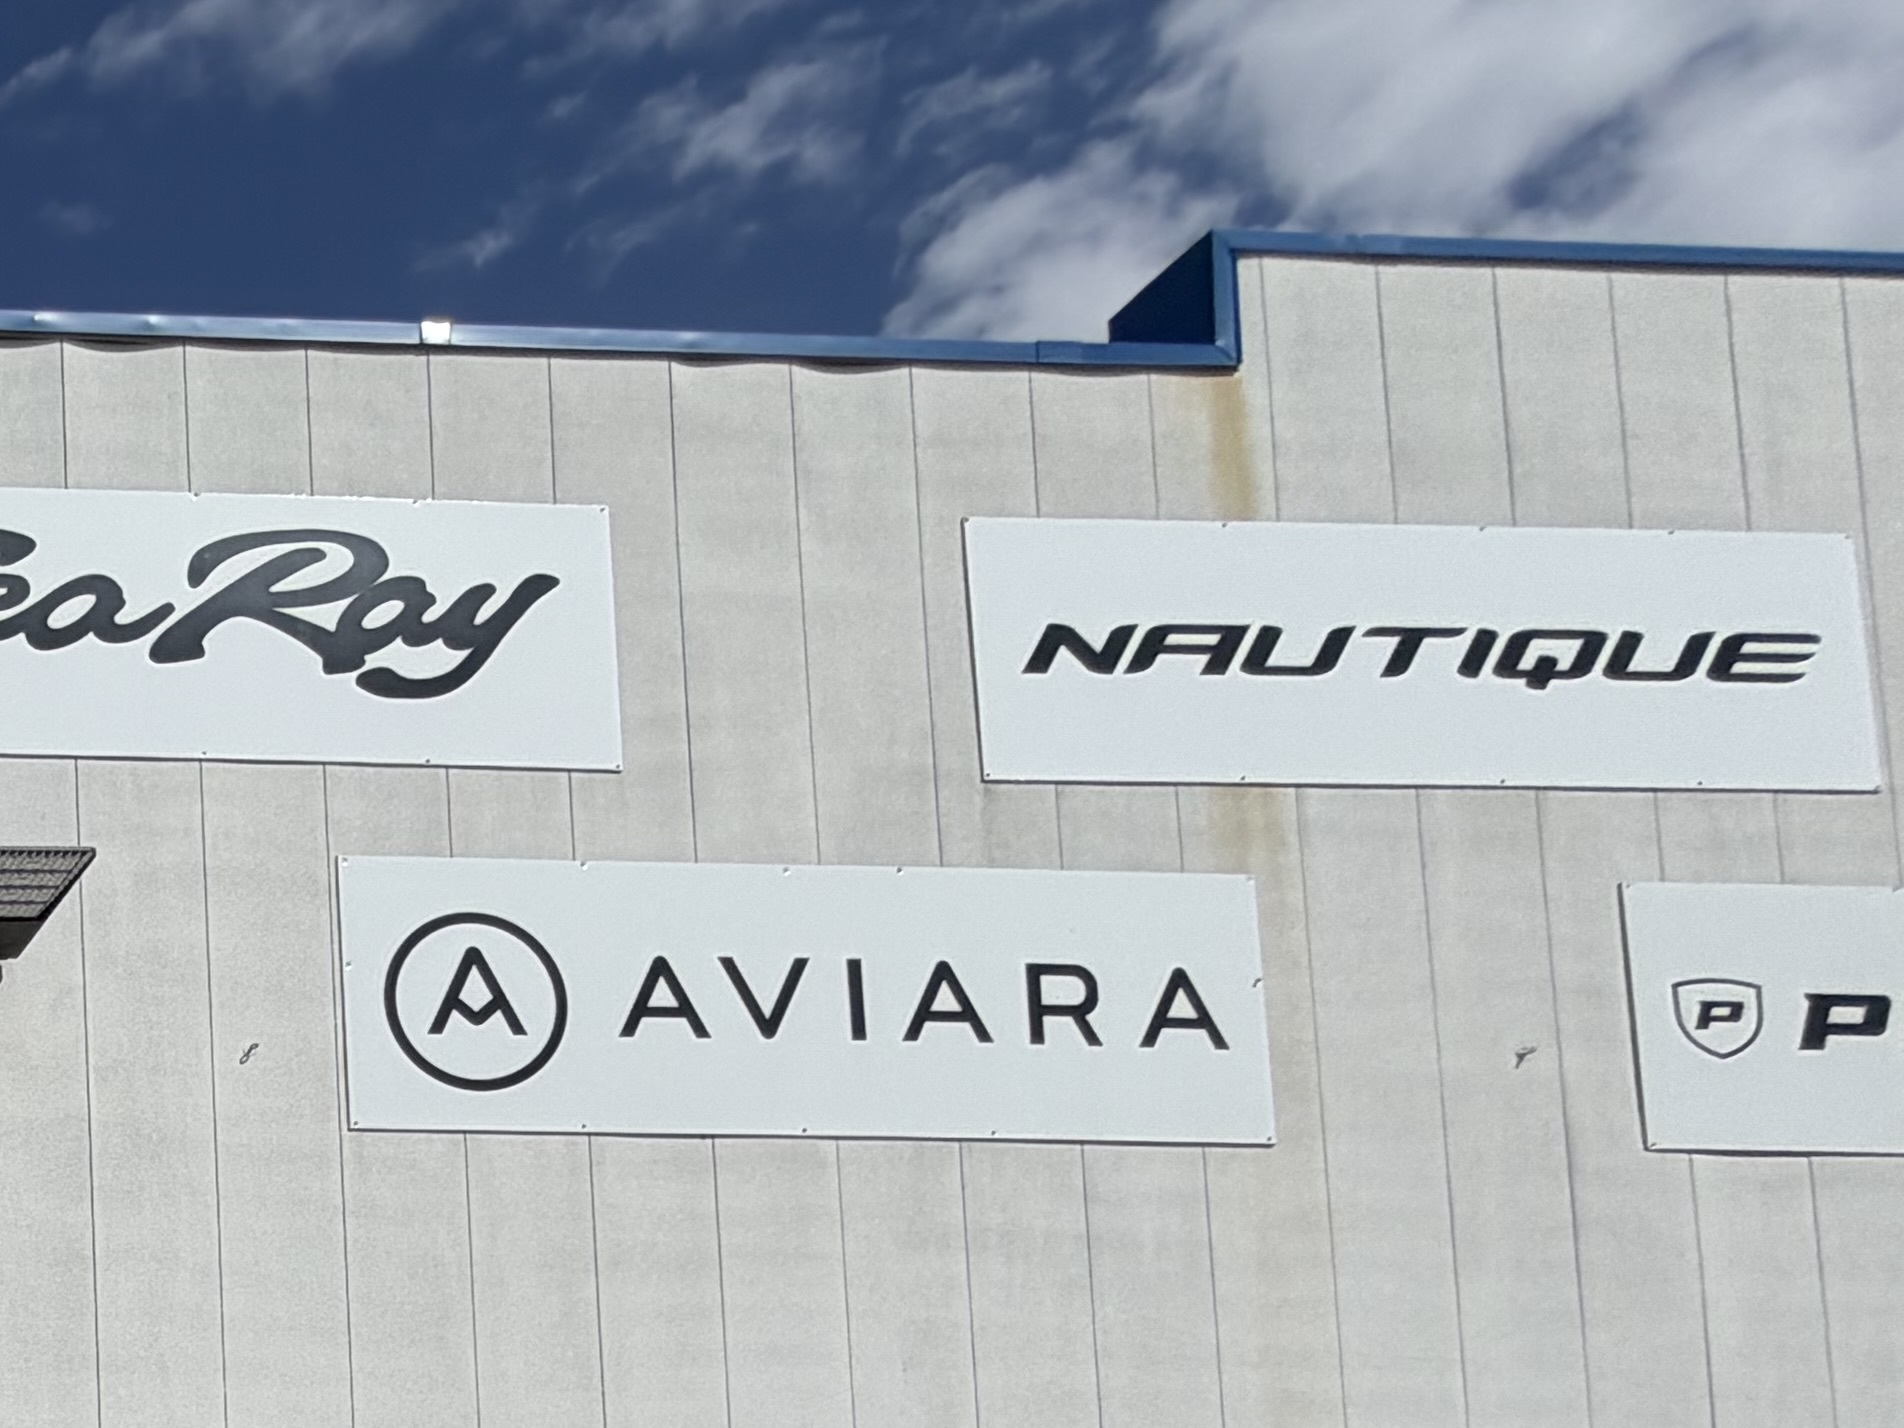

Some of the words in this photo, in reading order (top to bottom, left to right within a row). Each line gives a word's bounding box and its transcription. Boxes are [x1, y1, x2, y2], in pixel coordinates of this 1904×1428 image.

[148, 528, 560, 699] Ray
[1022, 623, 1821, 691] NAUTIQUE
[619, 955, 1230, 1051] AVIARA
